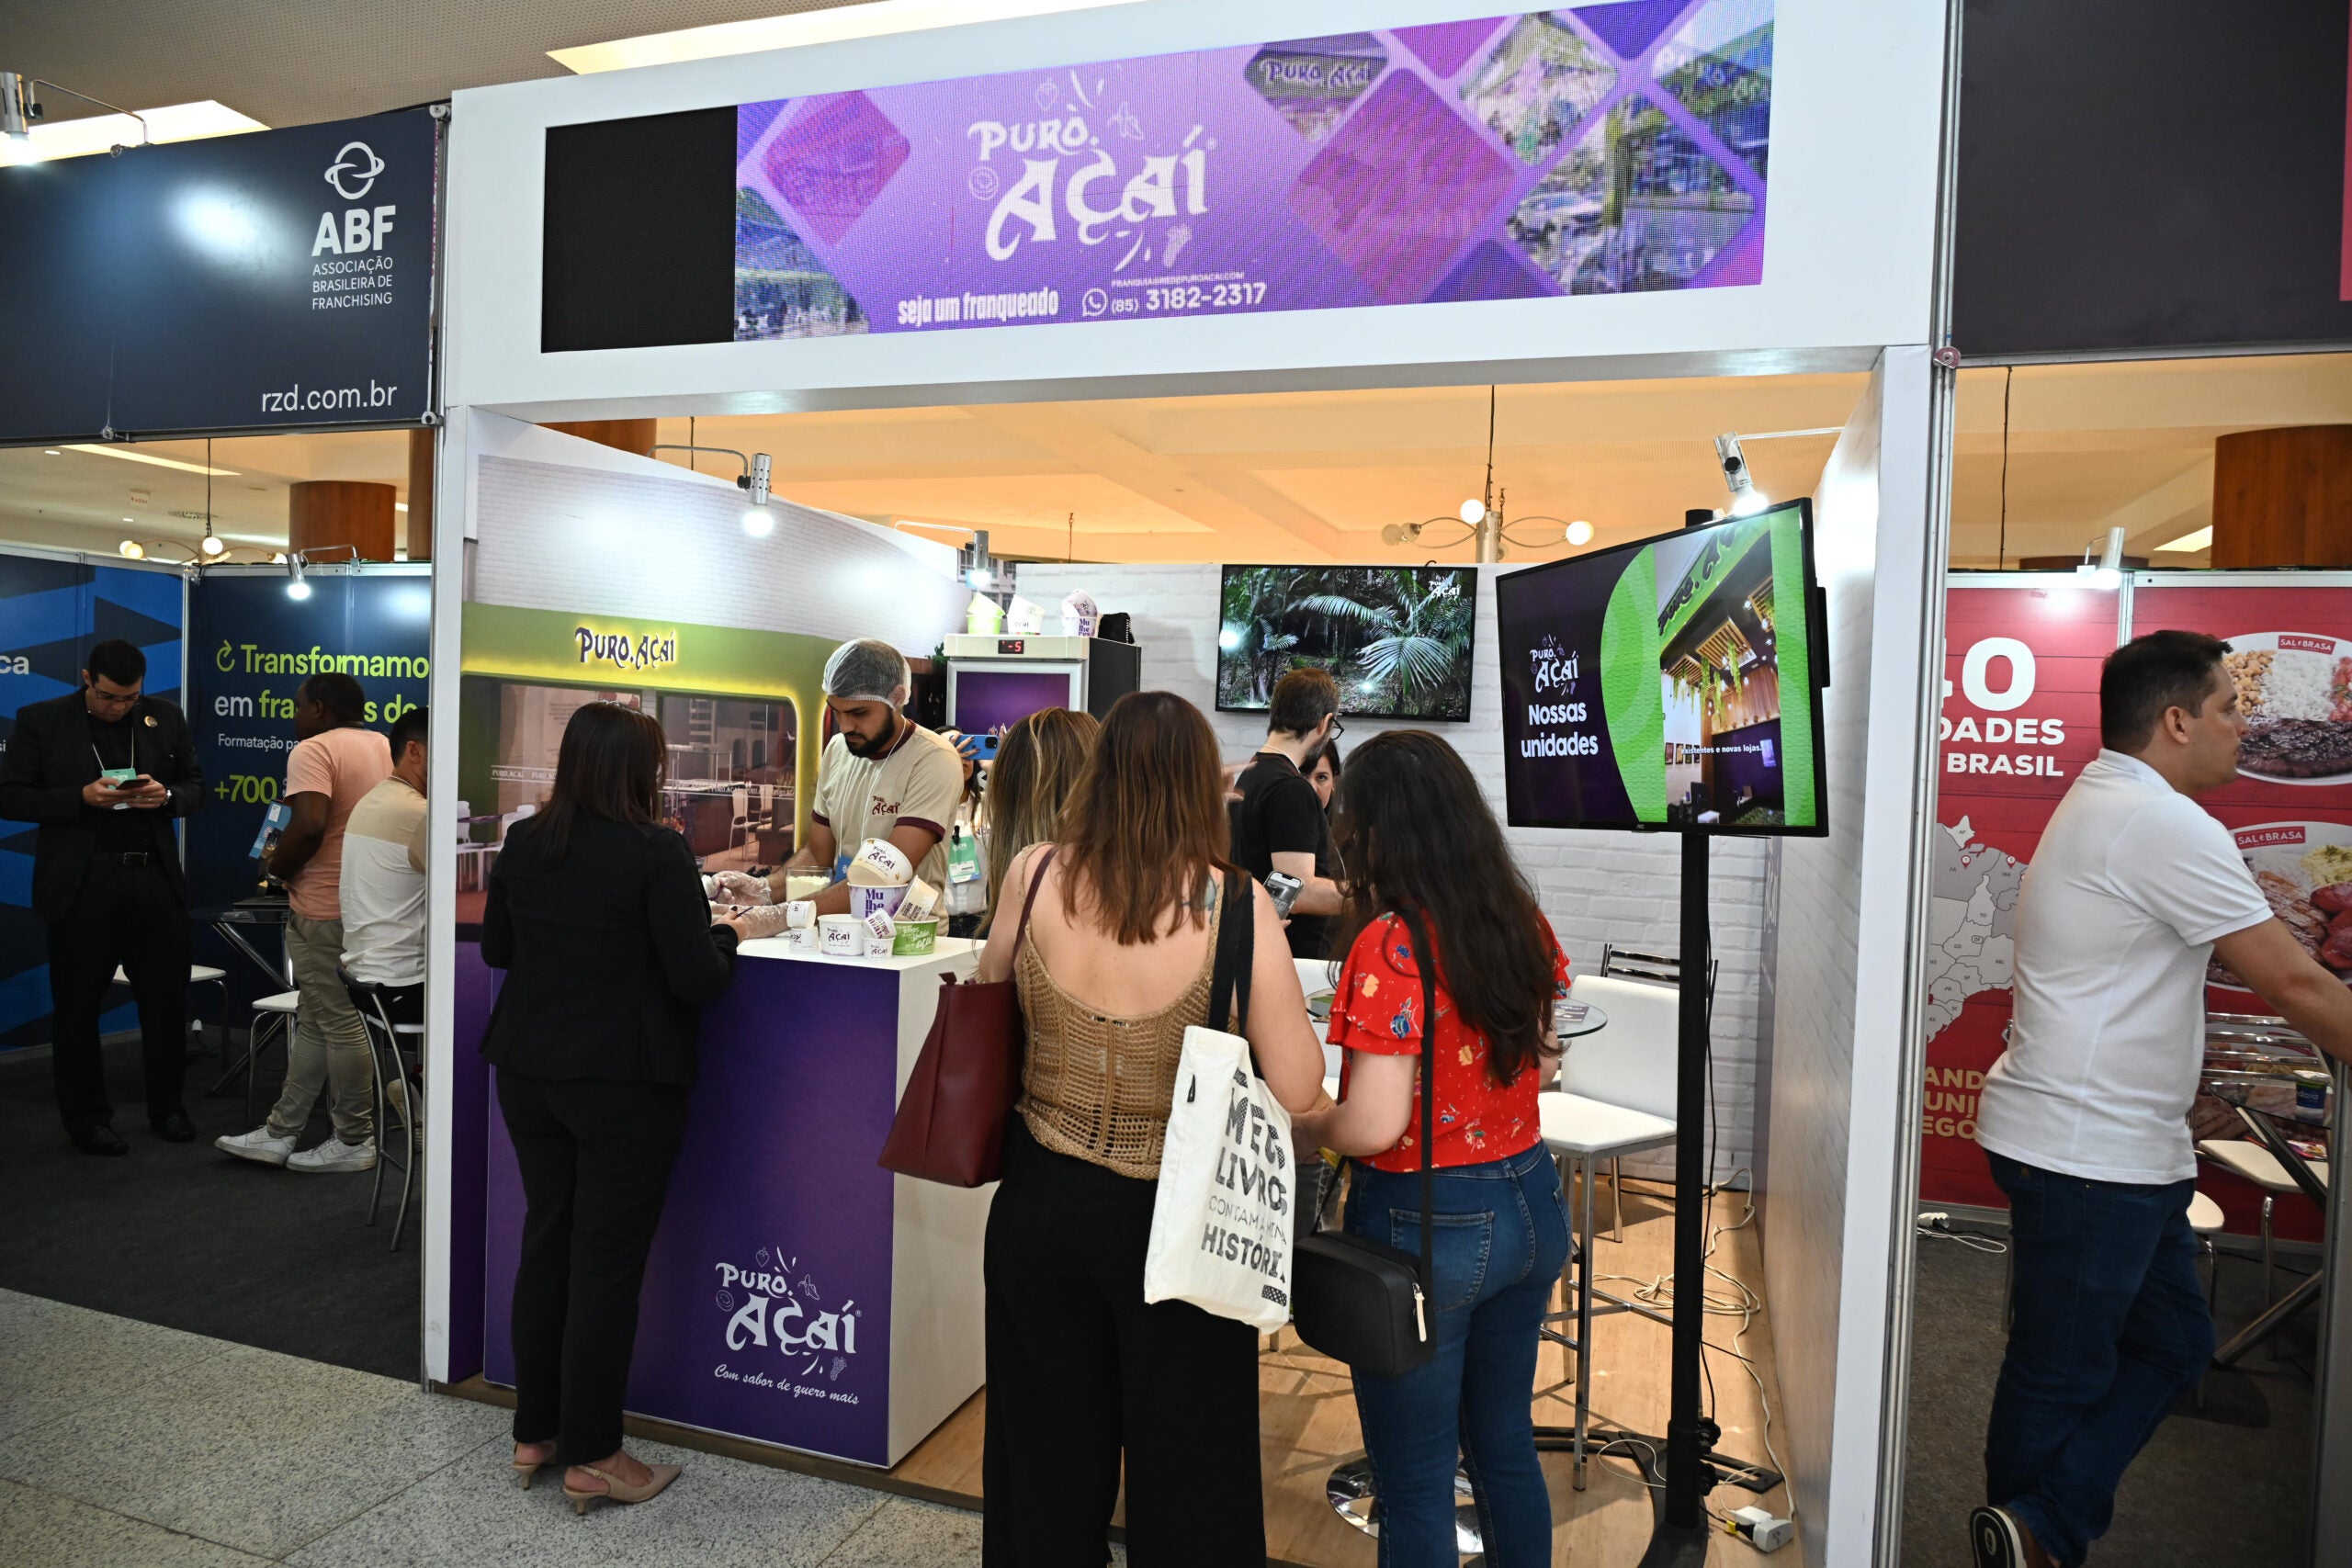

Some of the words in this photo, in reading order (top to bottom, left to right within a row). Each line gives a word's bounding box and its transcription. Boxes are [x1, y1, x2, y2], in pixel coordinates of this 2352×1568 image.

[985, 124, 1209, 262] AÇAÍ
[311, 205, 396, 256] ABF
[312, 255, 393, 276] ASSOCIAÇÃO
[312, 276, 376, 293] BRASILEIRA
[378, 275, 393, 288] DE
[1112, 299, 1139, 314] (85)
[1146, 282, 1267, 310] 3182-2317
[312, 292, 392, 310] FRANCHISING
[898, 294, 933, 327] seja
[934, 297, 960, 321] um
[964, 287, 1059, 321] franqueado
[262, 379, 398, 412] rzd.com.br
[2279, 638, 2297, 647] SAL
[2301, 640, 2332, 651] BRASA
[1535, 650, 1579, 694] AÇAÍ
[1941, 637, 2037, 712] 0
[214, 694, 253, 717] em
[383, 694, 418, 723] d
[1528, 702, 1588, 726] Nossas
[218, 733, 284, 752] Formatação
[1521, 731, 1599, 758] unidades
[1680, 746, 1714, 754] existentes
[1722, 744, 1742, 752] novas
[1947, 752, 2064, 777] BRASIL
[214, 774, 277, 805] +700
[2237, 834, 2259, 845] SAL
[2265, 830, 2303, 841] BRASA
[865, 888, 884, 900] Mu
[1209, 1195, 1259, 1230] CONTAM
[726, 1292, 857, 1357] AÇAÍ
[714, 1363, 740, 1382] Com
[742, 1372, 775, 1389] sabor
[776, 1378, 791, 1392] de
[794, 1383, 827, 1398] quero
[829, 1392, 860, 1405] mais
